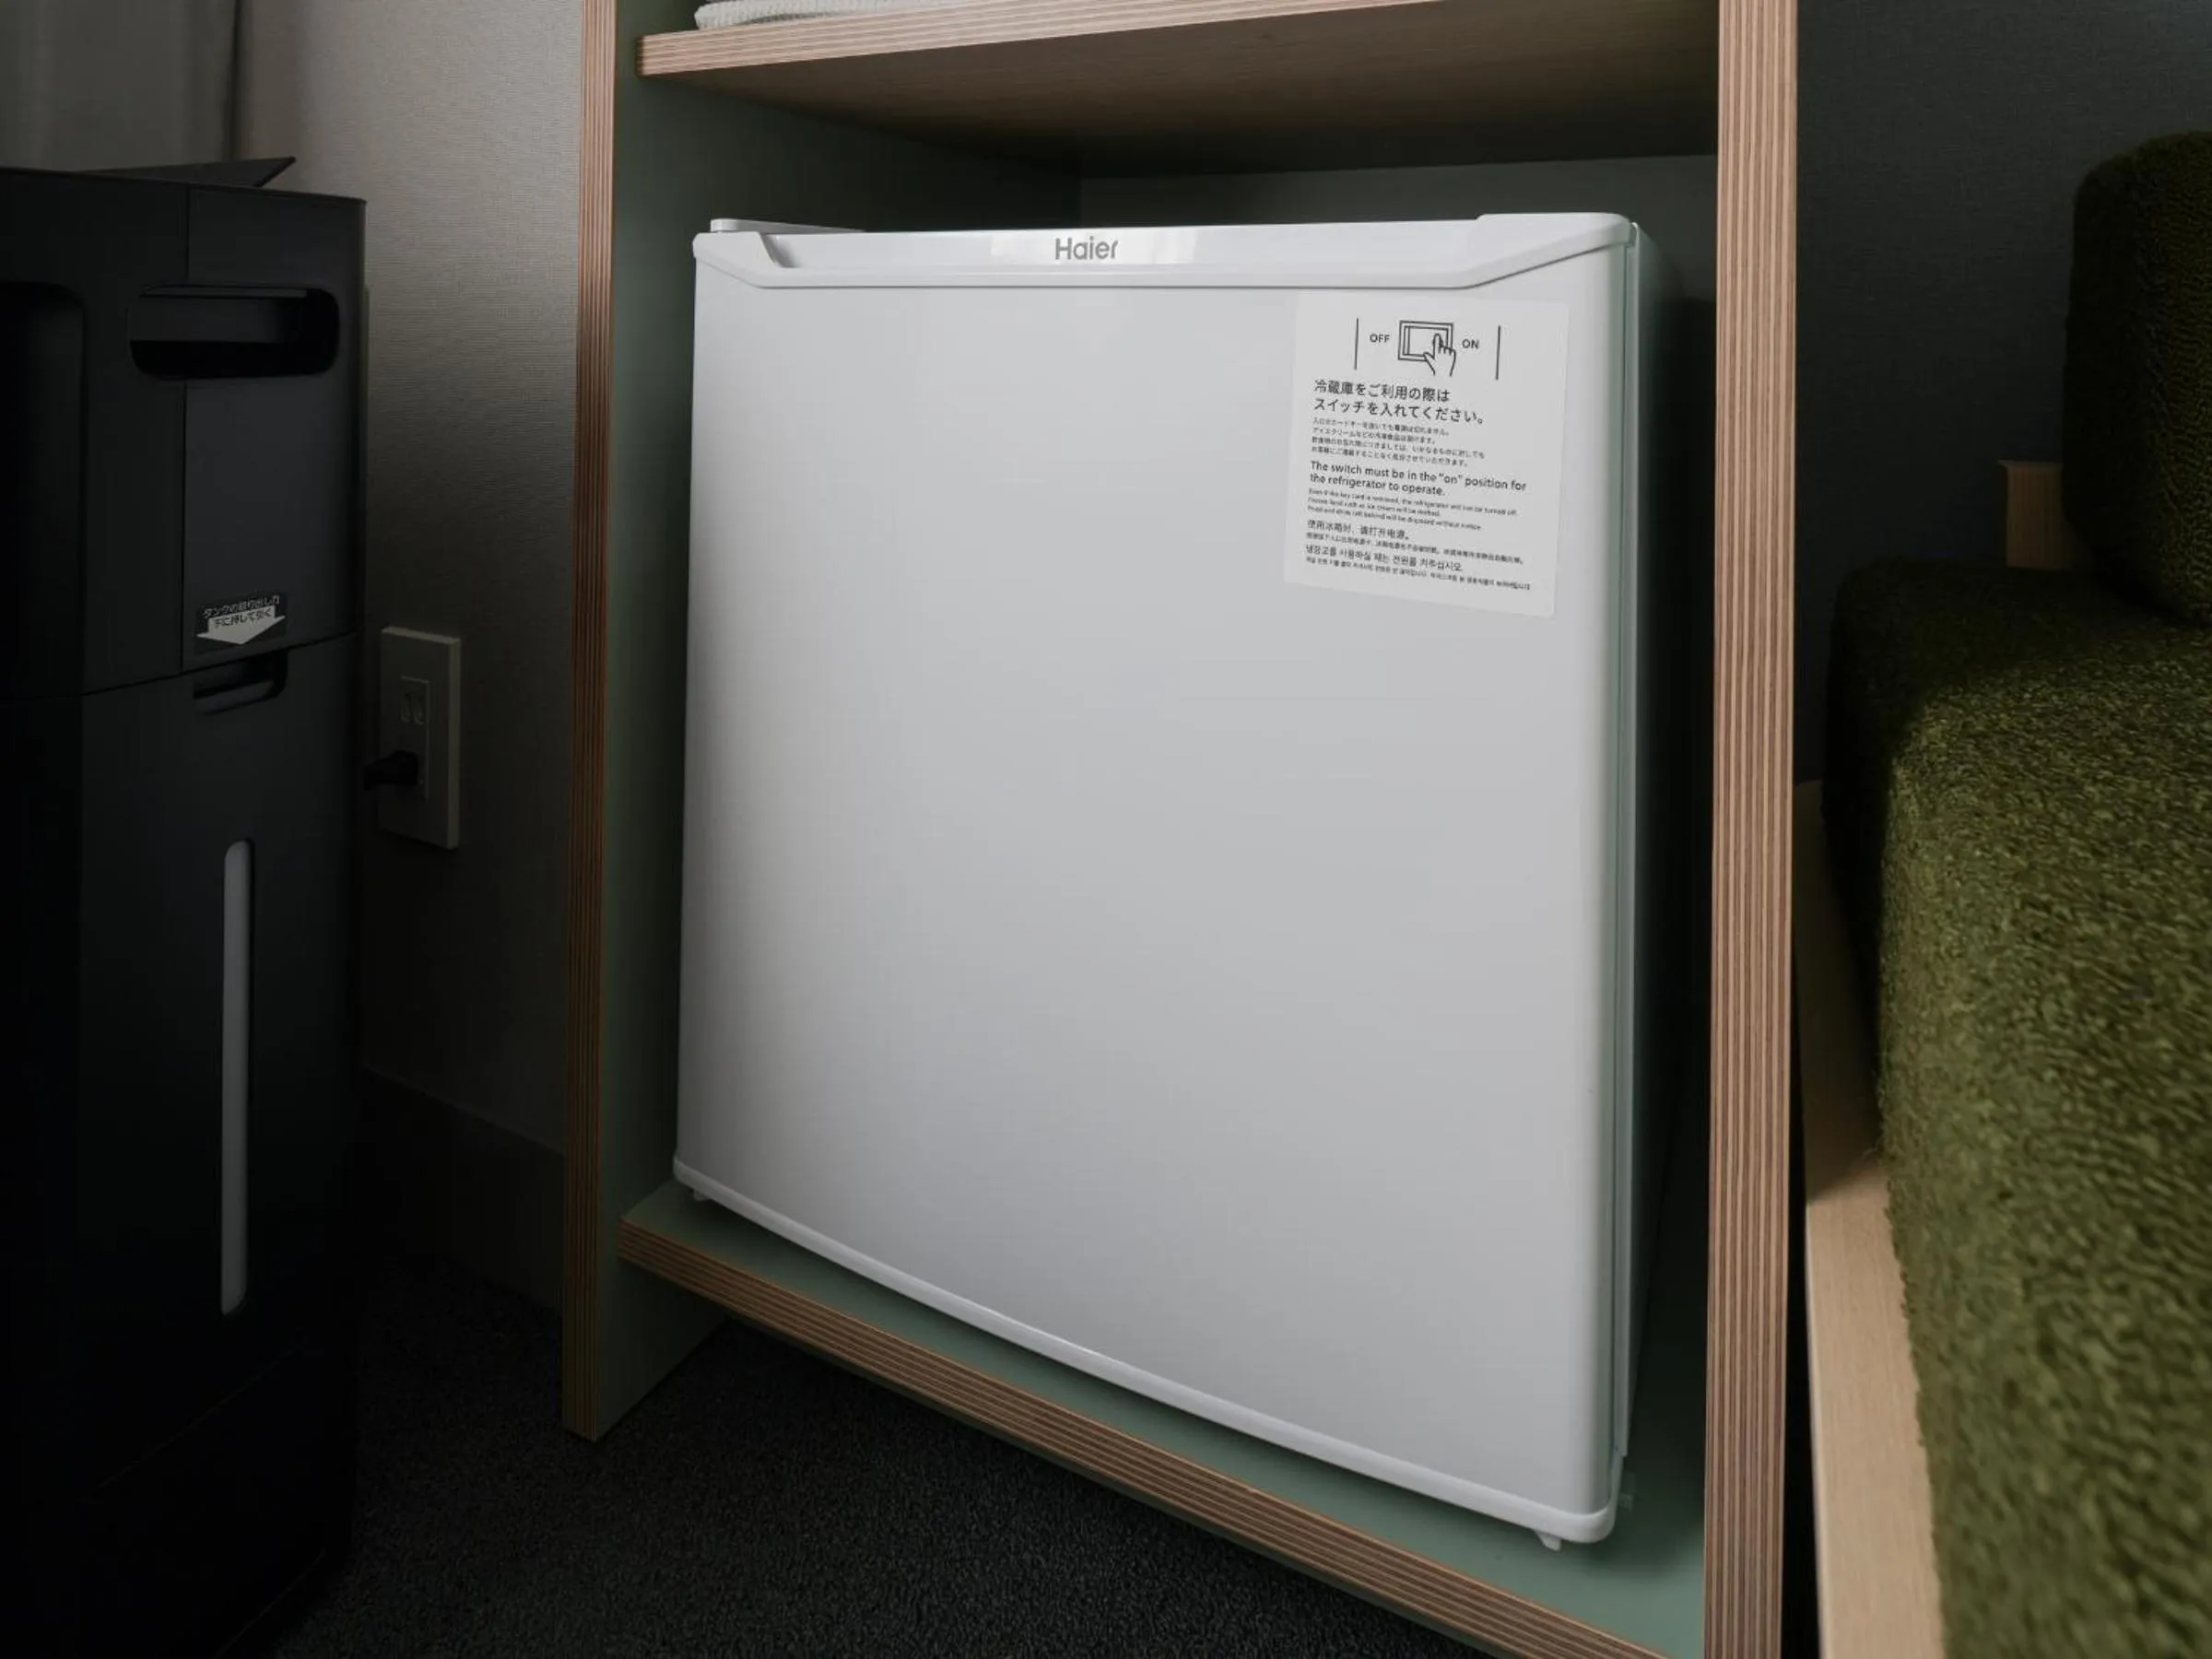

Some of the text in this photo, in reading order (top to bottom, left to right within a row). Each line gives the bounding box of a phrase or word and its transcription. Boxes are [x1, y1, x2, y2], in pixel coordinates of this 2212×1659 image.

[1055, 236, 1118, 260] Haier
[1370, 333, 1390, 343] OFF
[1462, 339, 1479, 349] ON
[1314, 379, 1451, 402] 冷蔵庫をご利用の際は
[1314, 398, 1483, 424] スイッチを入れてください。
[1310, 473, 1445, 496] the refrigerator to operate.
[1311, 460, 1328, 471] The
[1331, 464, 1362, 475] switch
[1365, 468, 1389, 477] must
[1392, 468, 1405, 479] be
[1407, 470, 1417, 480] in
[1419, 471, 1437, 482] the
[1465, 477, 1508, 489] position
[1511, 479, 1526, 491] for
